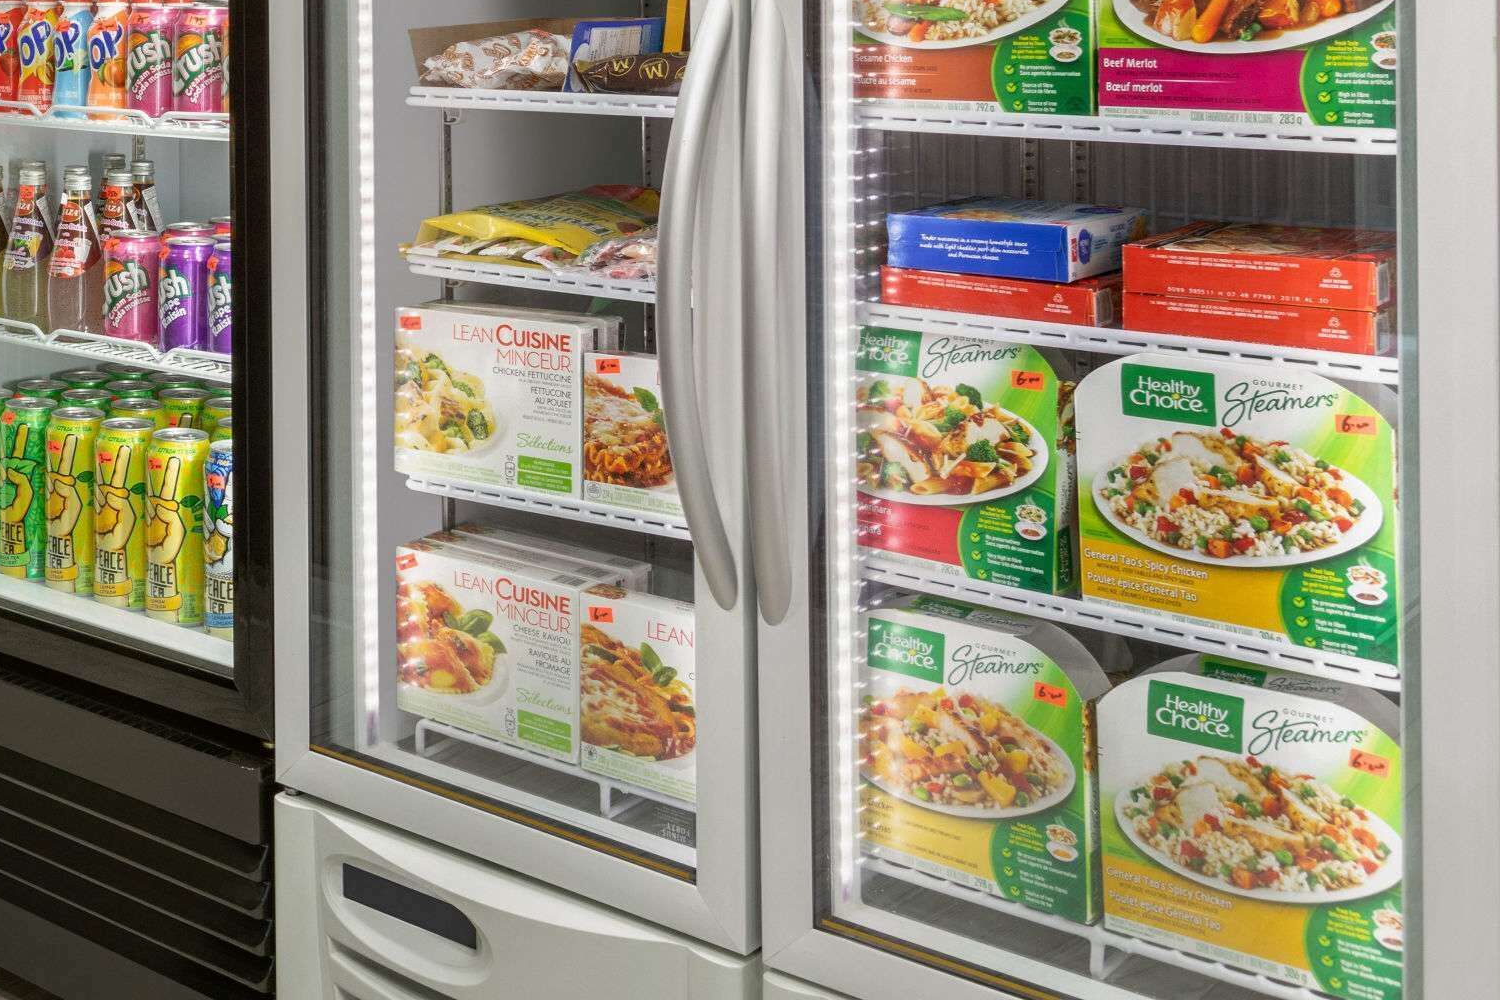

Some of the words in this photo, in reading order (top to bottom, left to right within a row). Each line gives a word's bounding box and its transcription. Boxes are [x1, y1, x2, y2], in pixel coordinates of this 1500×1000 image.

[854, 53, 883, 63] Sesame
[884, 53, 913, 63] Chicken
[1103, 58, 1124, 68] Beef
[1125, 58, 1158, 69] Merlot
[131, 69, 151, 94] Cream
[150, 60, 171, 73] Soda
[877, 78, 887, 86] au
[1132, 81, 1163, 93] merlot
[1279, 113, 1296, 125] 283
[452, 323, 493, 343] LEAN
[953, 335, 996, 345] GOURMET
[496, 348, 572, 374] MINCEUR
[922, 337, 1022, 379] Steamers
[492, 366, 525, 378] CHICKEN
[527, 370, 572, 384] FETTUCCINE
[1137, 374, 1201, 398] Healthy
[1252, 379, 1304, 391] GOURMET
[530, 386, 572, 399] FETTUCCINE
[534, 397, 545, 406] AU
[547, 399, 572, 409] POULET
[1129, 387, 1208, 413] Choice
[1221, 382, 1338, 428] Steamers
[1083, 547, 1119, 563] General
[1121, 554, 1143, 568] Tao's
[1145, 559, 1170, 575] Spicy
[1171, 564, 1208, 580] Chicken
[454, 568, 493, 595] LEAN
[1086, 571, 1116, 586] Poulet
[1180, 590, 1198, 602] Tao
[496, 600, 571, 634] MINCEUR
[512, 623, 541, 638] CHEESE
[542, 629, 571, 645] RAVIOLI
[647, 619, 694, 649] LEAN
[881, 631, 934, 655] Healthy
[561, 656, 571, 666] AU
[874, 642, 936, 671] Choice
[974, 641, 1018, 657] GOURMET
[535, 660, 571, 676] FROMAGE
[947, 641, 1044, 687] Steamers
[1165, 693, 1229, 720] Healthy
[1282, 708, 1335, 724] GOURMET
[1155, 707, 1234, 739] Choice
[1248, 709, 1368, 756] Steamers
[1107, 867, 1142, 882] General
[1143, 874, 1166, 890] Tao's
[1167, 882, 1193, 899] Spicy
[1194, 889, 1233, 909] Chicken
[1202, 915, 1221, 931] Tao
